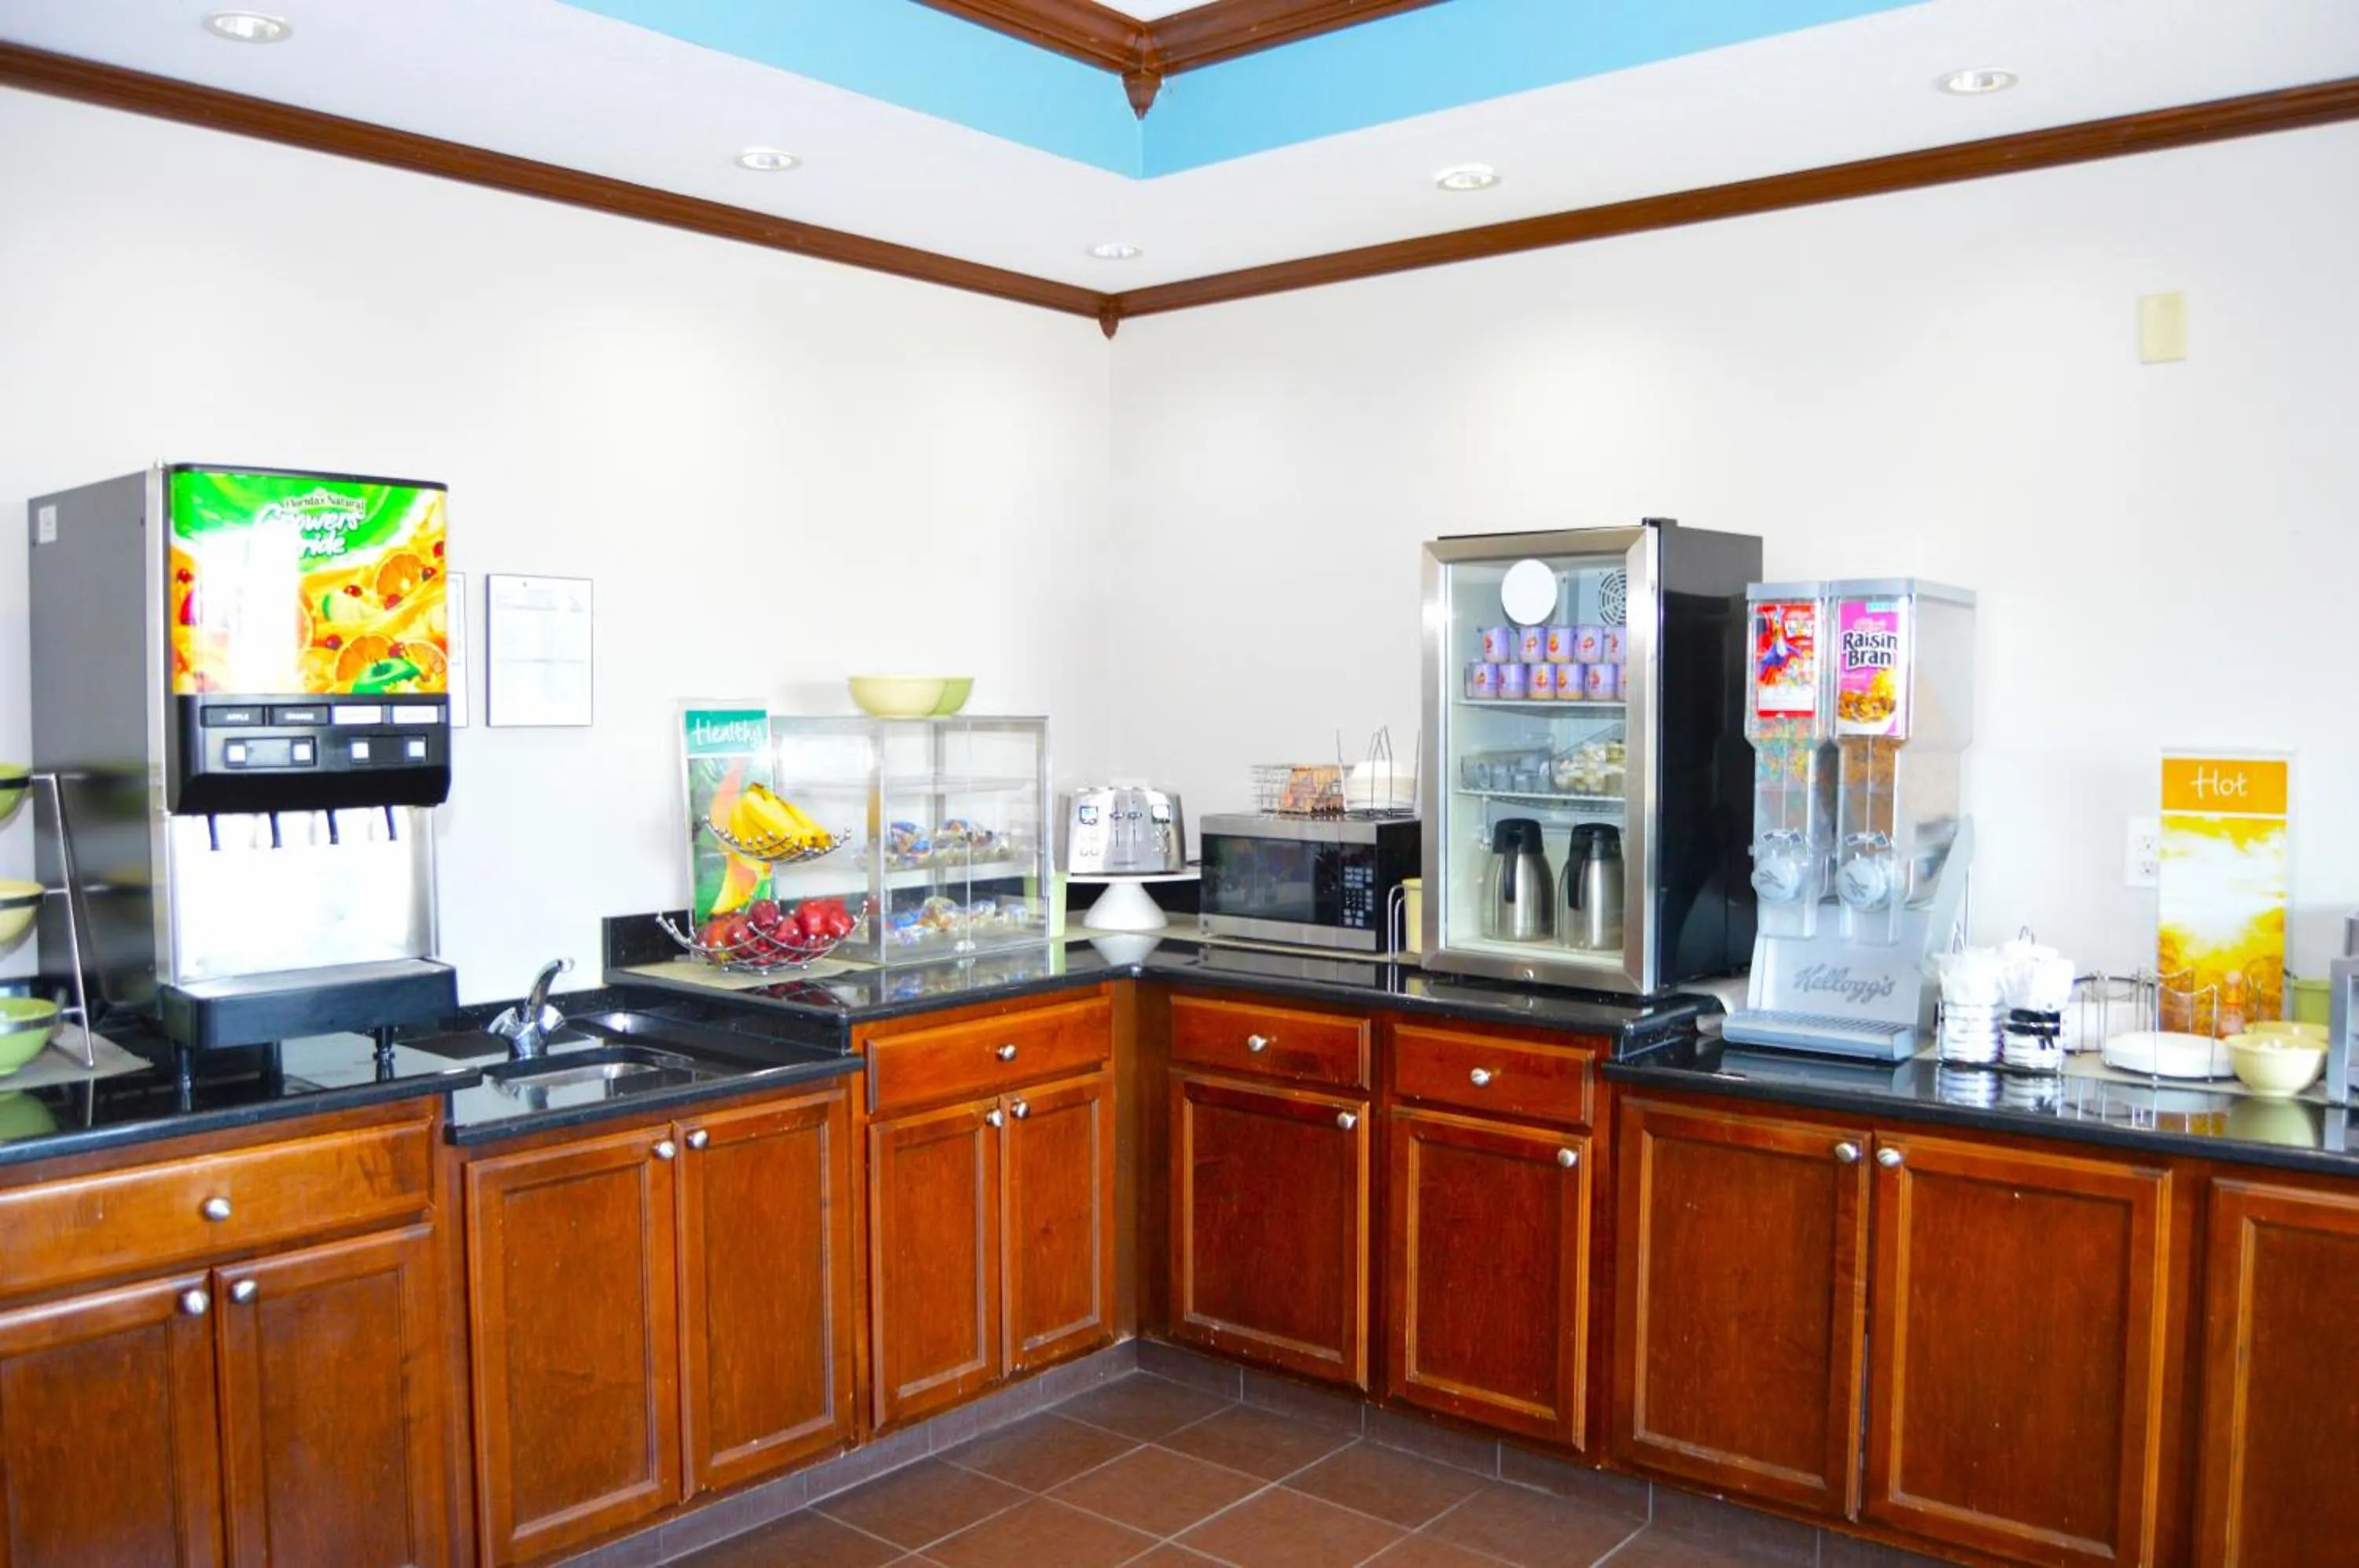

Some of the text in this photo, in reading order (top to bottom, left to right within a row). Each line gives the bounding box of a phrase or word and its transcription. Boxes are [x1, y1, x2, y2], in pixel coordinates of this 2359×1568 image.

[326, 493, 364, 510] Natural
[1842, 631, 1898, 651] Raisin
[1848, 650, 1892, 667] Bran
[691, 717, 763, 748] Healthy
[2189, 765, 2249, 800] Hot
[1793, 962, 1897, 1004] Kellogg's
